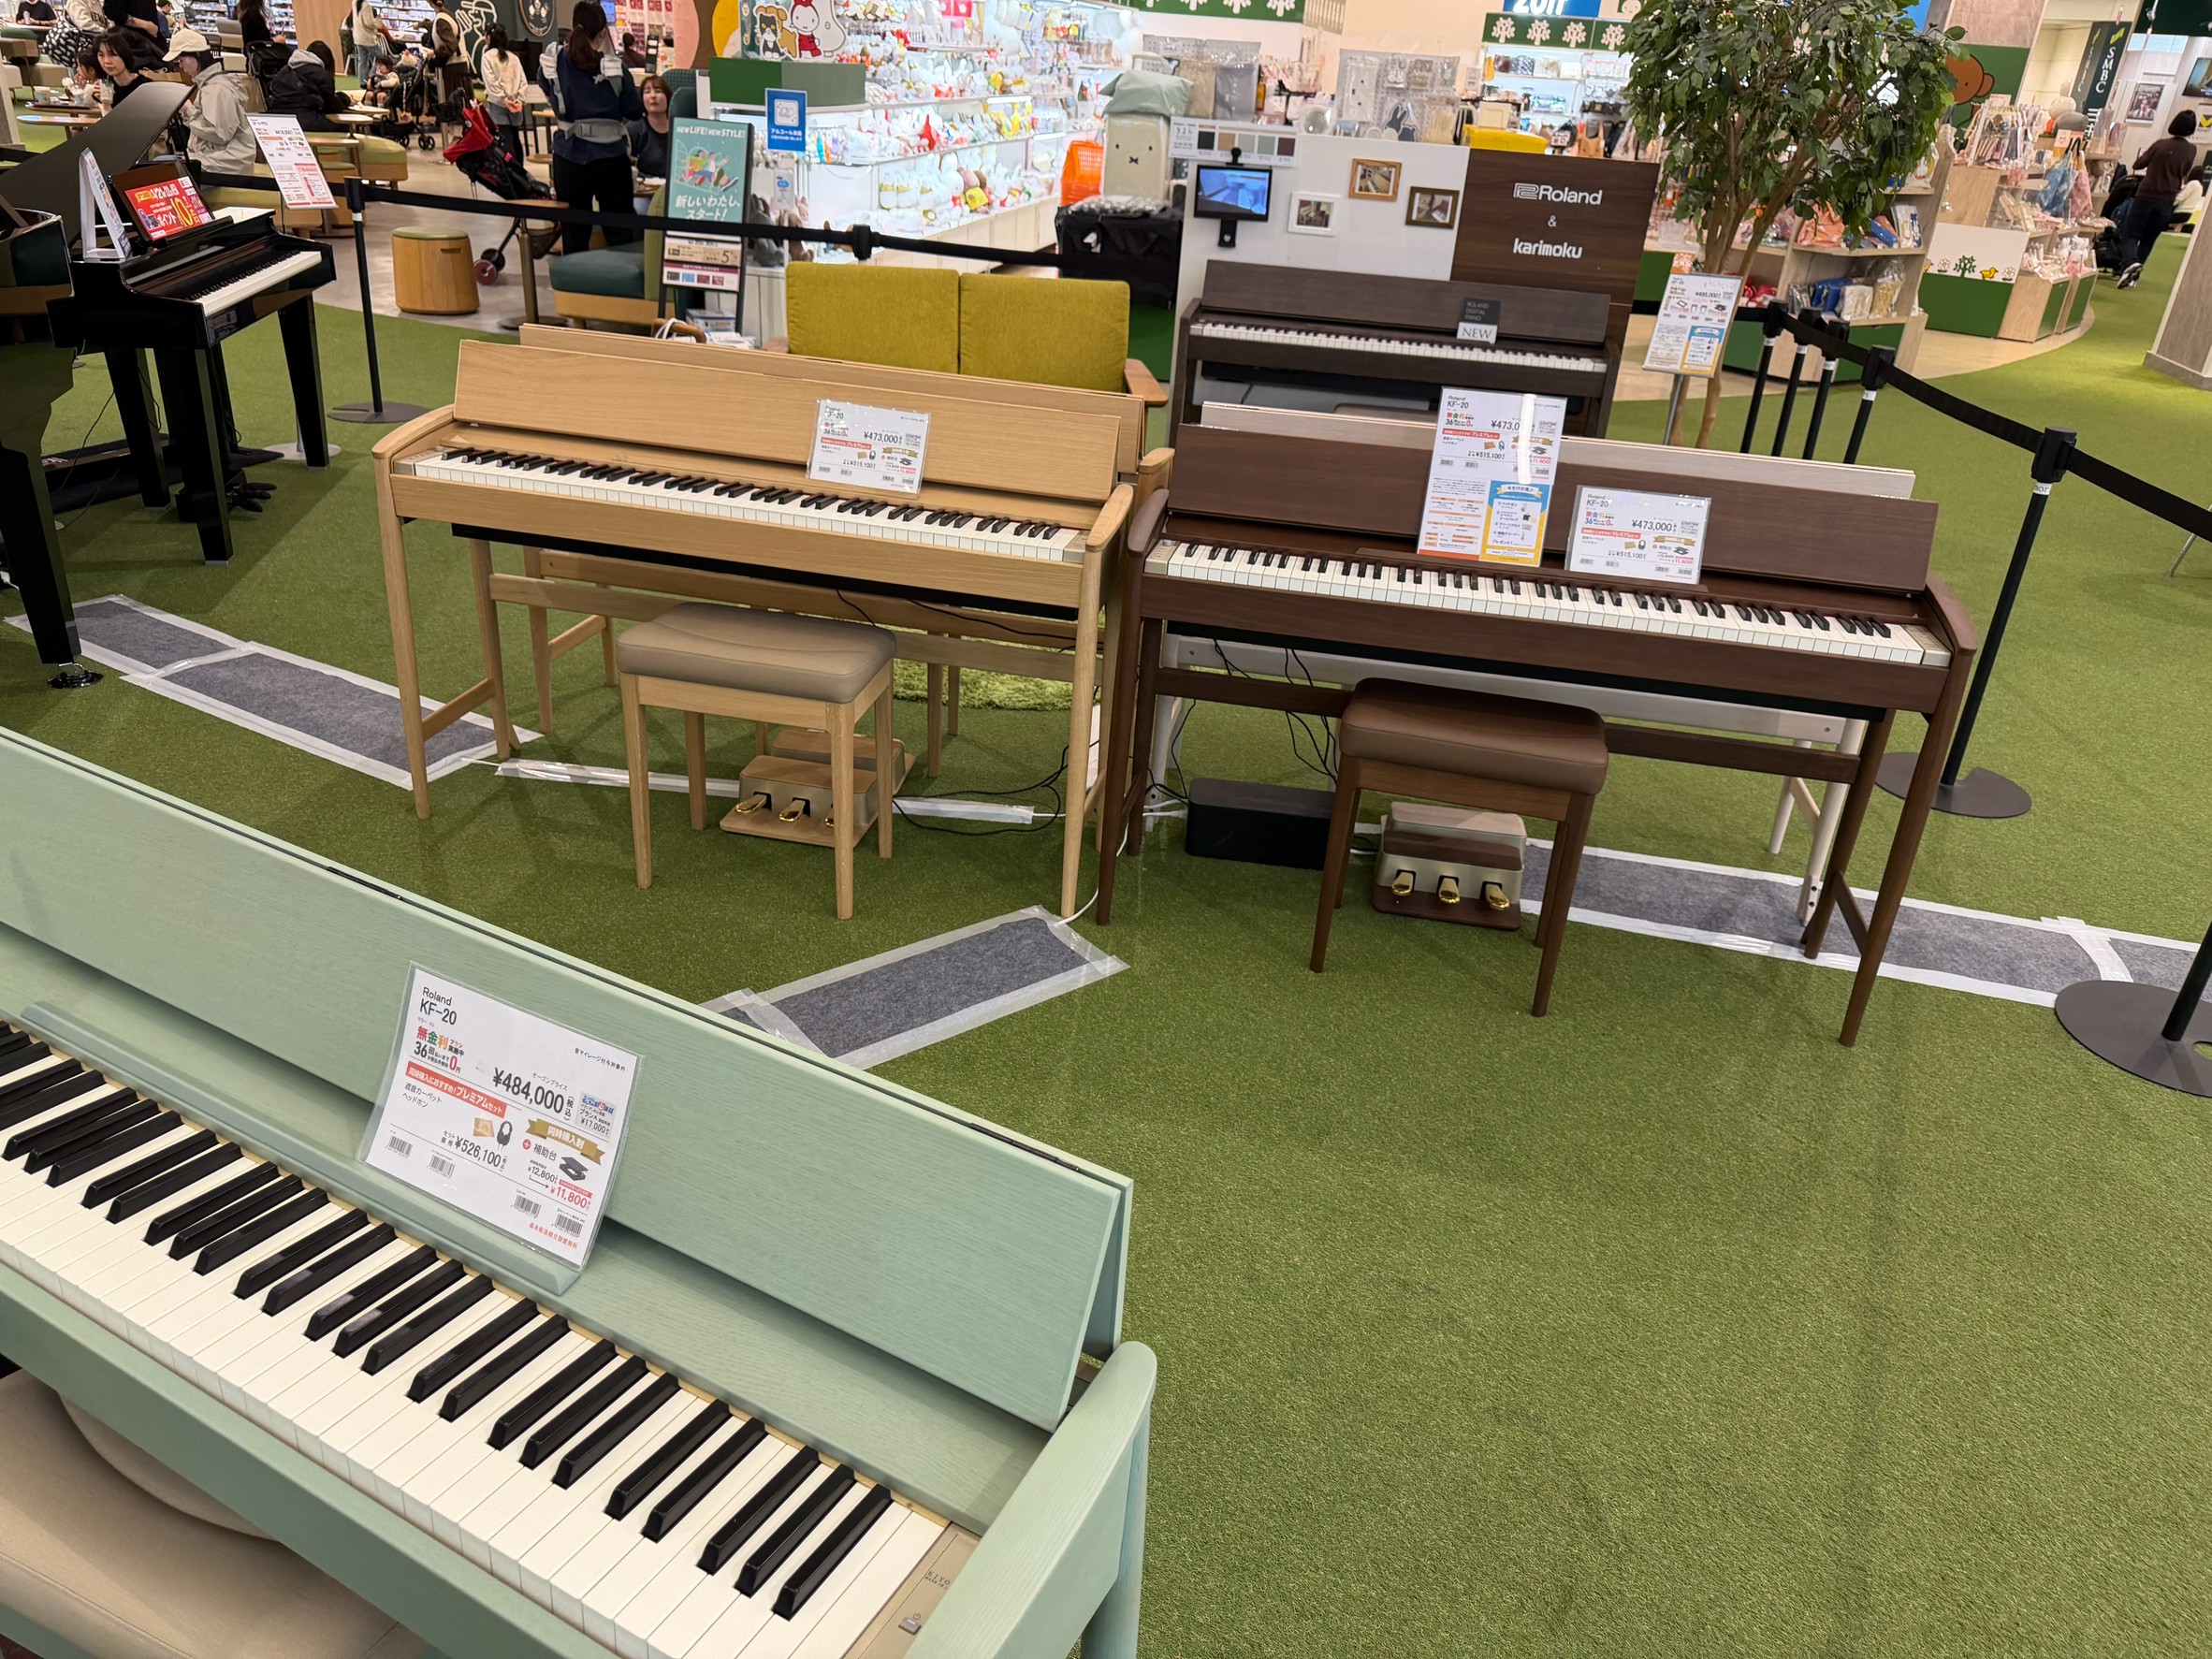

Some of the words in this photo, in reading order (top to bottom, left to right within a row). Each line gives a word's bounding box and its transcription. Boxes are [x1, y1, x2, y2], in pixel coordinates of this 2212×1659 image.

[2096, 47, 2116, 93] SMBC
[690, 125, 708, 135] LIFE!
[720, 128, 746, 138] STYLE!
[1538, 184, 1603, 205] Roland
[675, 195, 740, 208] 新しいわたし、
[1548, 215, 1557, 227] &
[1513, 238, 1583, 259] karimoku
[1466, 301, 1490, 310] ROLAND
[1462, 327, 1492, 339] NEW
[1447, 400, 1469, 409] KF-20
[1491, 419, 1521, 431] ¥473,0
[864, 430, 898, 444] ¥473,000
[1586, 499, 1609, 507] KF-20
[1631, 518, 1673, 531] ¥473,000
[421, 986, 453, 1007] Roland
[419, 997, 458, 1026] KF-20
[415, 1026, 449, 1050] 無金利
[532, 1142, 558, 1161] 補助台
[550, 1186, 588, 1209] ¥11,800
[928, 1571, 950, 1584] KIYO
